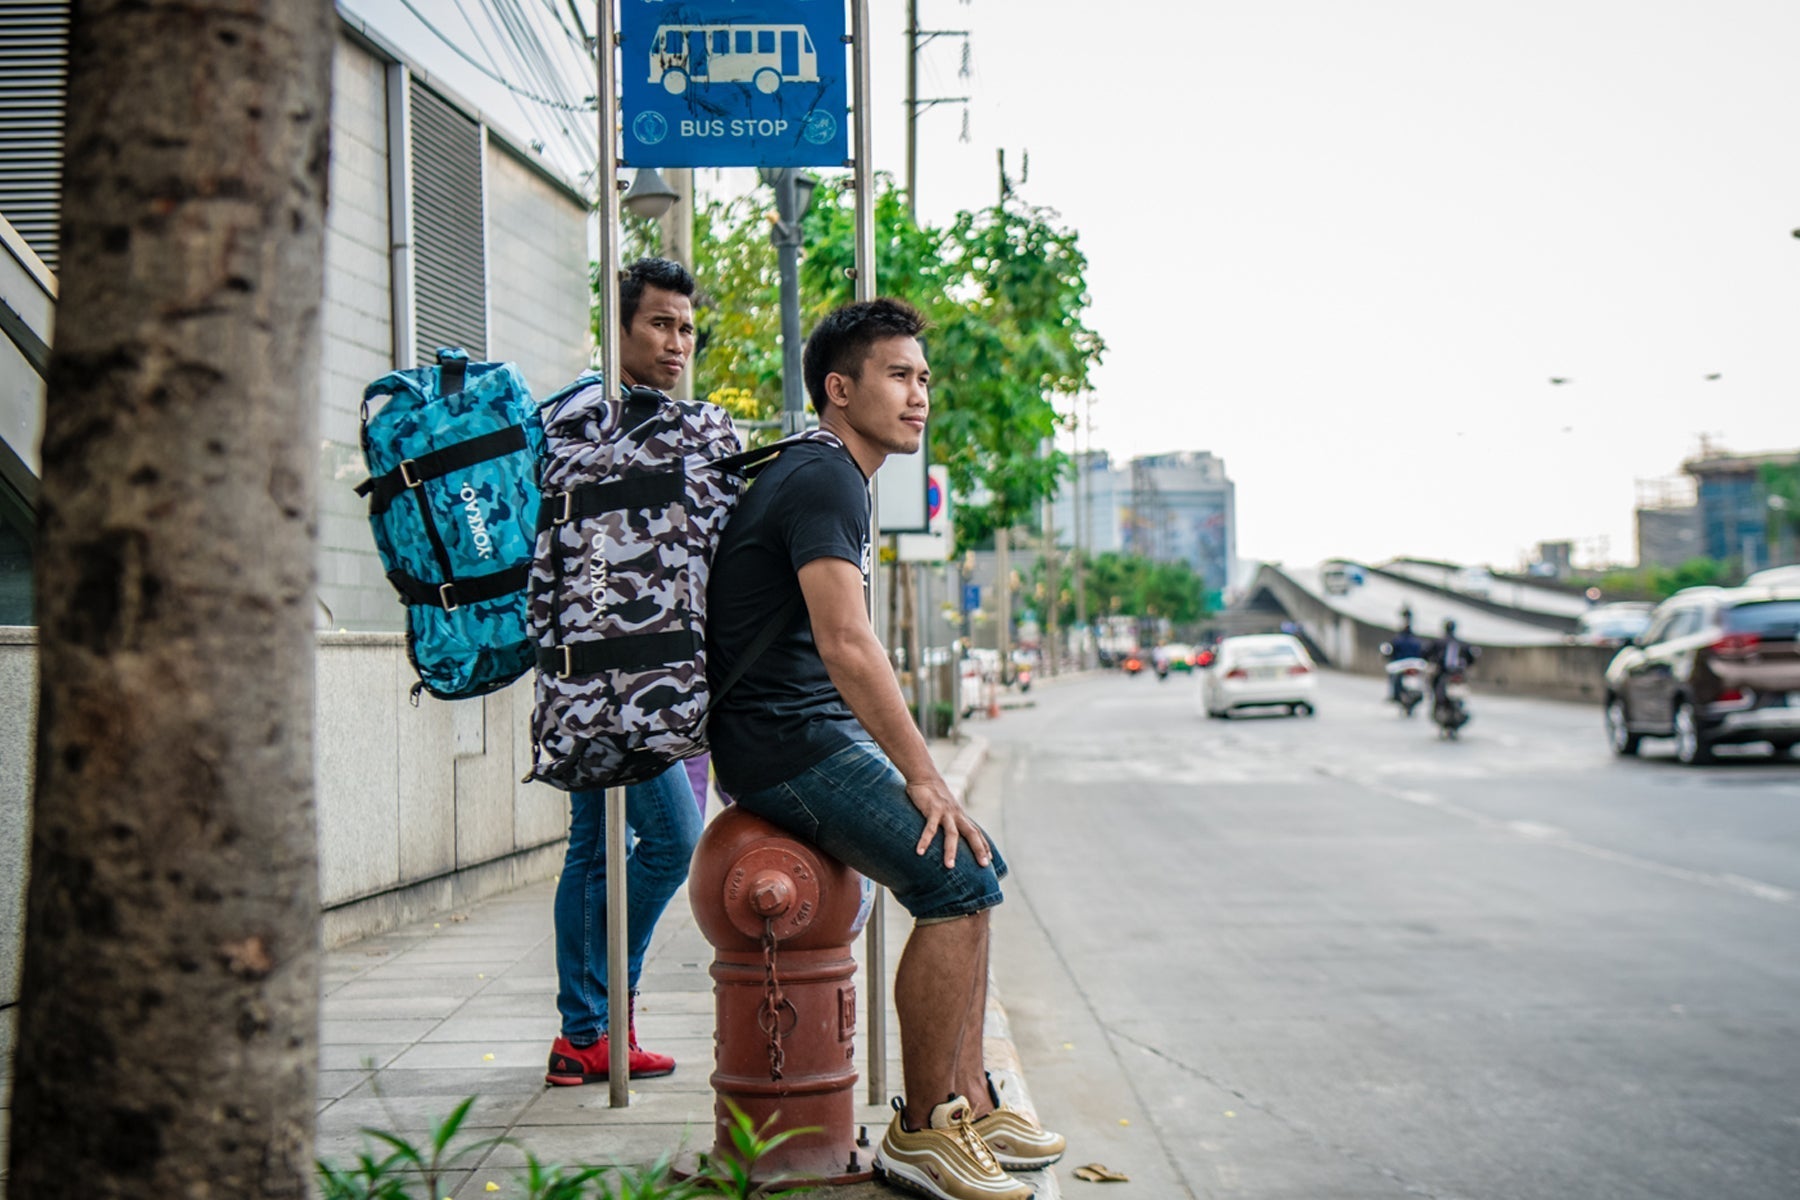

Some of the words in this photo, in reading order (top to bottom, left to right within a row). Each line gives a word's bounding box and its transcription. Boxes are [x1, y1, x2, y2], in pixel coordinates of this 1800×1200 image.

[680, 119, 725, 137] BUS
[730, 119, 788, 137] STOP
[460, 485, 493, 559] YOKKAO
[590, 532, 608, 620] YOKKAO
